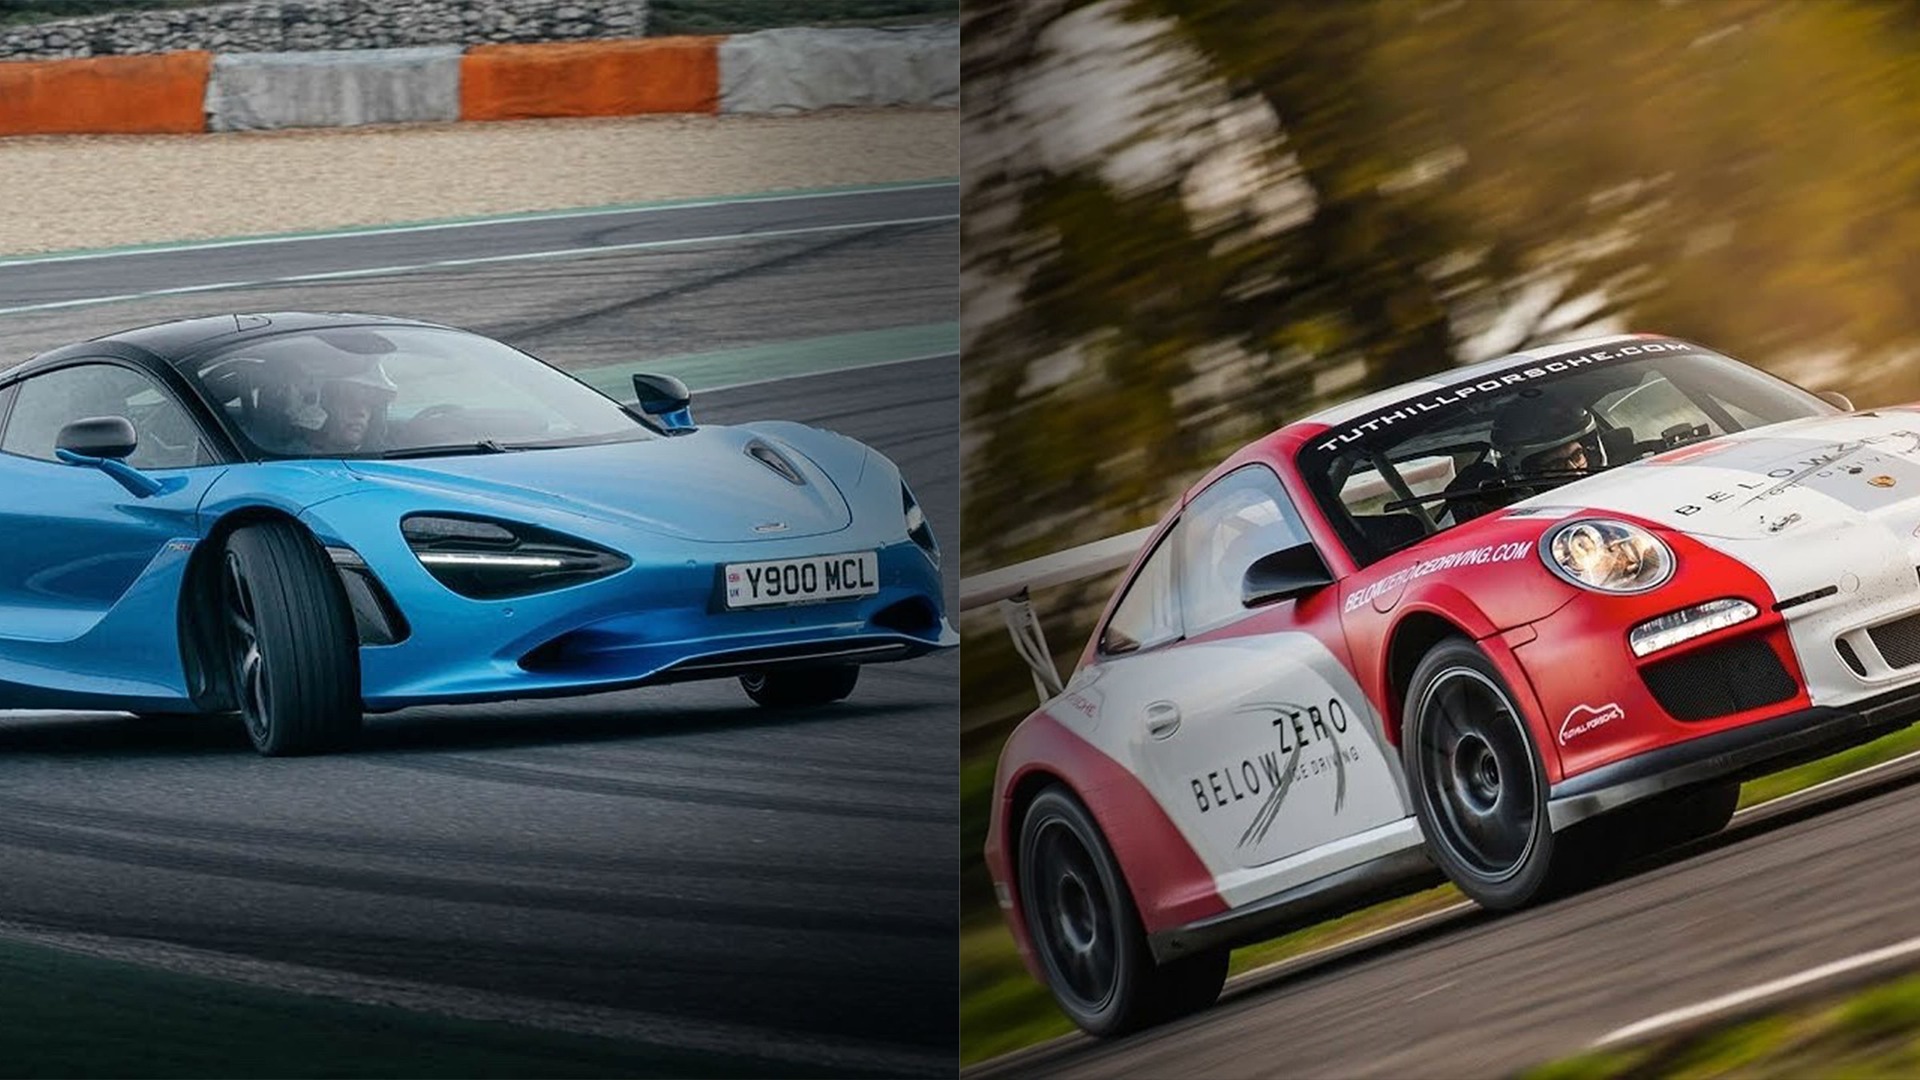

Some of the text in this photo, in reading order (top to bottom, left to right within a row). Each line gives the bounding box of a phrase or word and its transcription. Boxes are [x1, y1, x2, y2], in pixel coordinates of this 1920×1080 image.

[1317, 341, 1693, 452] TUTHILLPORSCHE.COM
[1674, 454, 1836, 517] BELOW
[729, 588, 740, 598] UK
[746, 558, 874, 598] Y900 MCL
[1344, 541, 1533, 613] BELOWZEROICEDRIVING.COM
[1190, 697, 1347, 814] BELOW ZERO
[1310, 745, 1360, 776] DRIVNG
